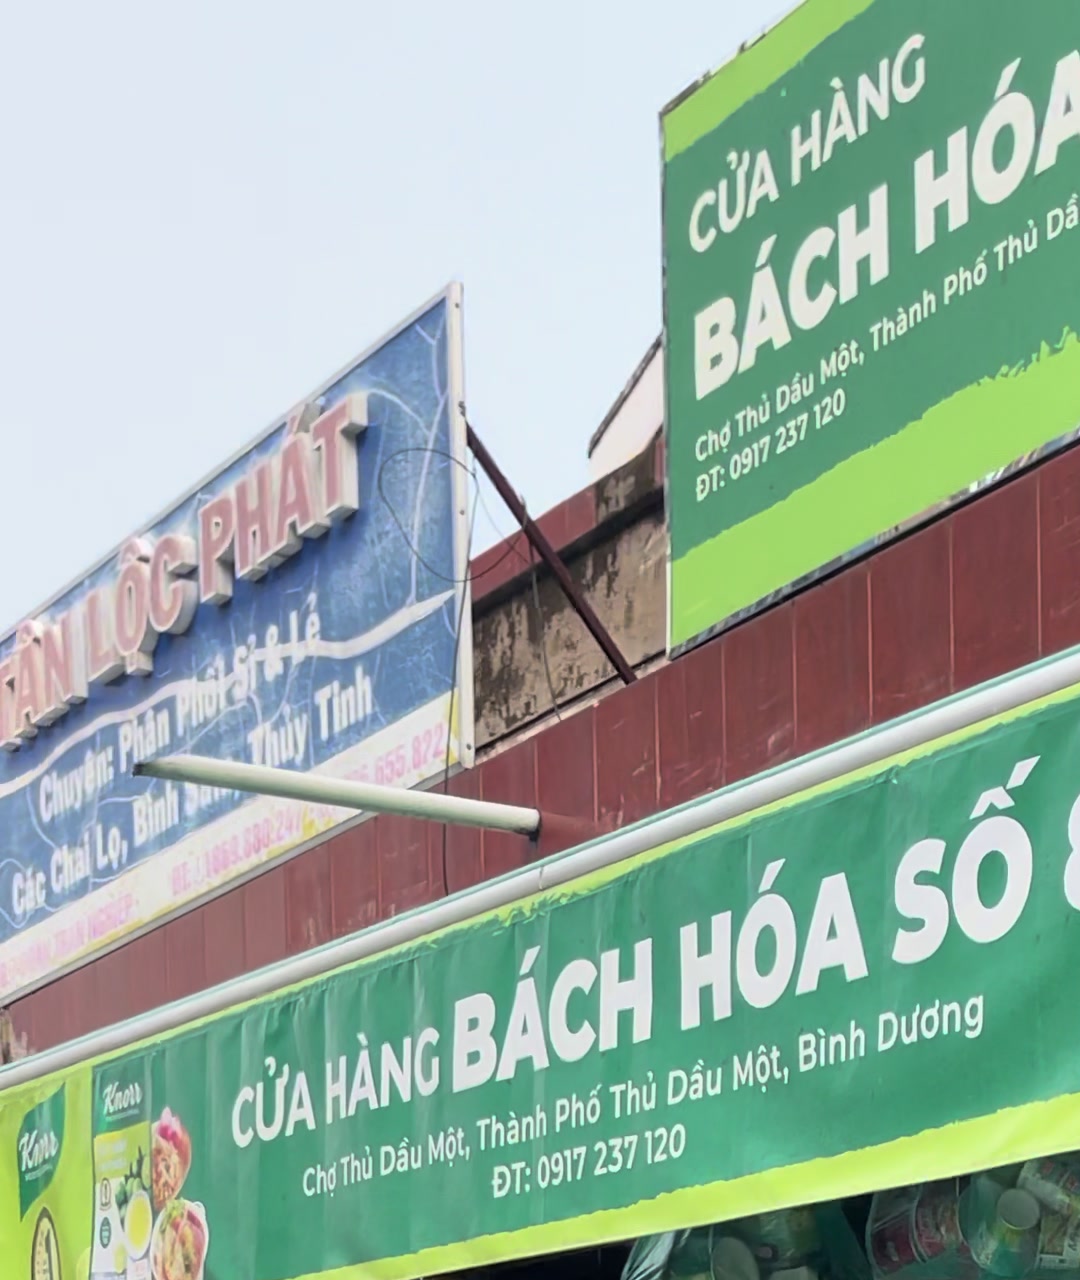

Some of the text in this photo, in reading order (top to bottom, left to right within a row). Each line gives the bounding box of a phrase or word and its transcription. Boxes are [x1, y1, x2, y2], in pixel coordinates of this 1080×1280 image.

[689, 33, 926, 253] CỬA HÀNG
[695, 184, 889, 400] BÁCH
[695, 419, 731, 463] Chợ
[734, 392, 771, 433] Thủ
[775, 367, 815, 412] Dầu
[819, 336, 865, 386] Một,
[869, 293, 936, 353] Thành
[942, 251, 988, 308] Phố
[994, 217, 1040, 272] Thủ
[87, 534, 197, 684] LỘC
[199, 391, 368, 605] PHÁT
[695, 388, 846, 502] ĐT: 0917 237 120
[315, 664, 372, 741] Tinh
[231, 1057, 316, 1147] CỬA
[325, 1030, 440, 1125] HÀNG
[451, 938, 654, 1093] BÁCH
[679, 857, 869, 1031] HÓA
[891, 755, 1041, 965] SỐ
[103, 1083, 142, 1114] Knorr
[302, 994, 985, 1198] Chợ Thủ Dầu Một, Thành Phố Thủ Dầu Một, Bình Dương
[491, 1122, 686, 1199] ĐT: 0917 237 120
